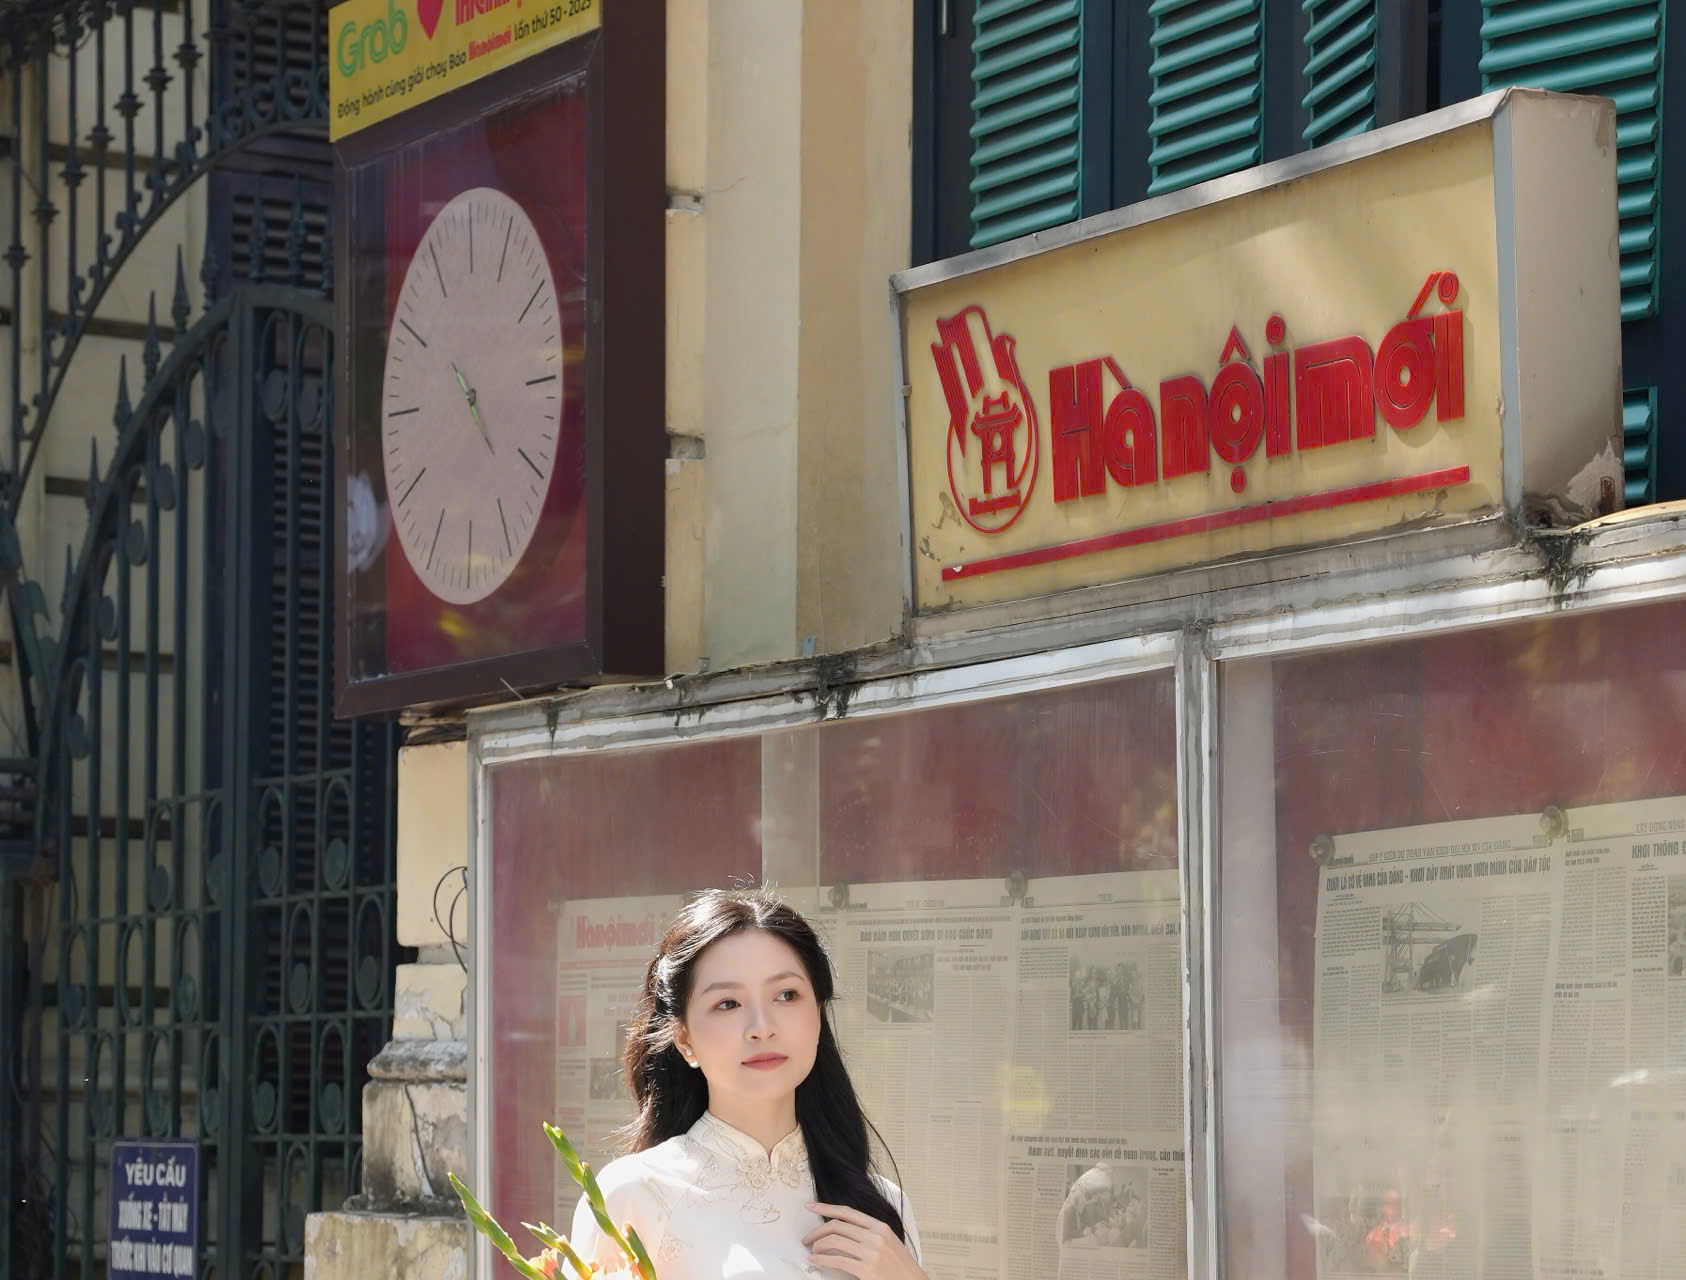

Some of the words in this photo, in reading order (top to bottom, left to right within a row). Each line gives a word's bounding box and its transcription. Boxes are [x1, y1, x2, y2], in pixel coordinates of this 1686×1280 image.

[336, 0, 409, 79] Grab
[337, 97, 361, 119] Đồng
[361, 86, 385, 109] hành
[385, 78, 407, 97] cùng
[425, 61, 448, 80] chạy
[448, 49, 468, 70] Báo
[531, 10, 549, 33] thứ
[550, 6, 563, 26] 50
[1048, 270, 1466, 504] Hànộimới
[125, 1155, 154, 1186] YÊU
[155, 1154, 187, 1188] CẦU
